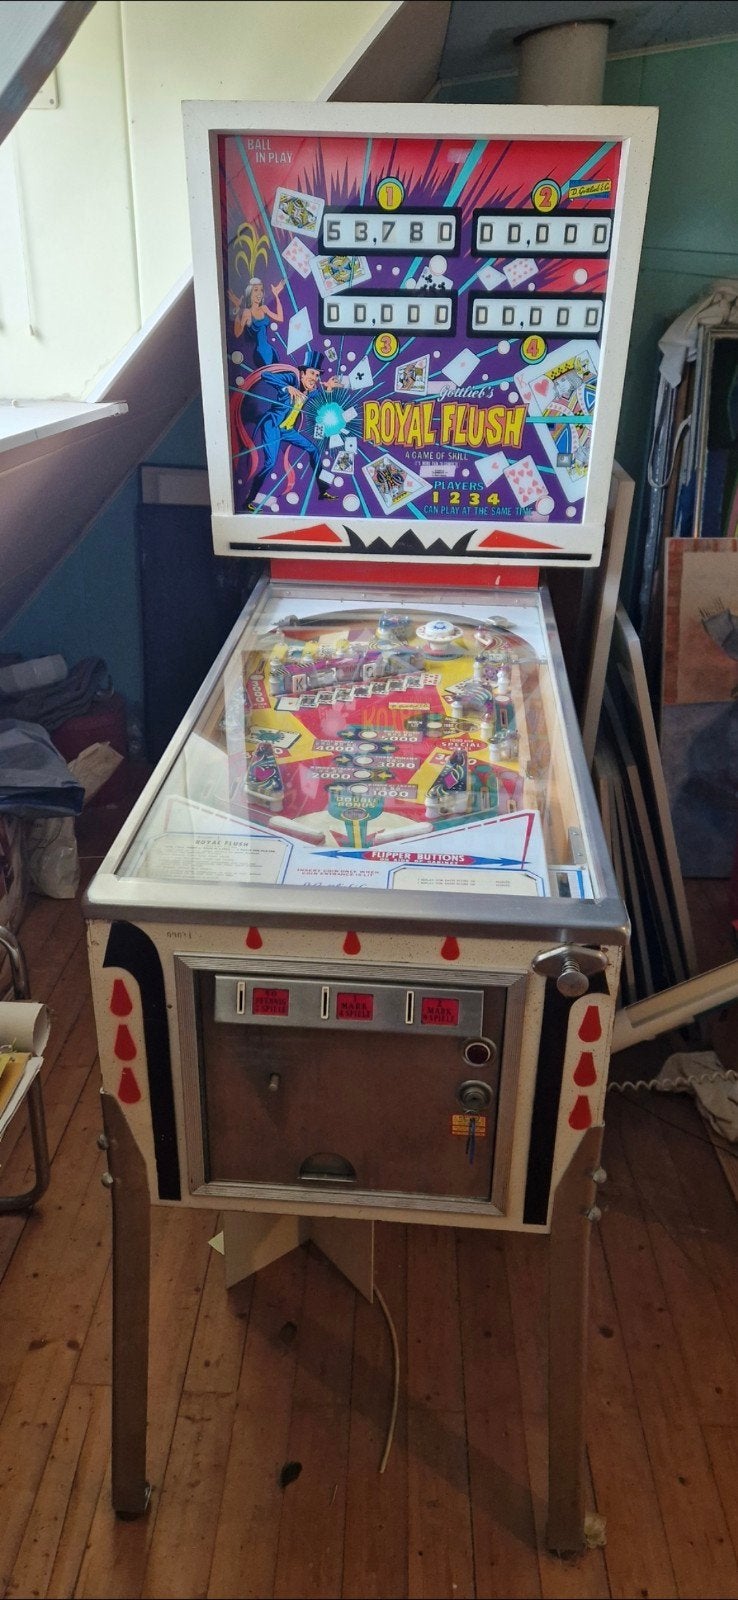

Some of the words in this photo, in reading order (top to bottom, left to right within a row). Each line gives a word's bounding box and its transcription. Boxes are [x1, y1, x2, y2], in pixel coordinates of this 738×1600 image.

[248, 139, 271, 150] BALL
[256, 152, 266, 163] IN
[268, 153, 293, 164] PLAY
[386, 186, 394, 206] 1
[539, 186, 552, 208] 2
[380, 335, 392, 354] 3
[527, 338, 539, 357] 4
[363, 399, 436, 449] ROYAL
[441, 402, 529, 449] FLUSH
[412, 452, 434, 460] GAME
[436, 452, 445, 460] OF
[448, 452, 469, 461] SKILL
[434, 481, 484, 491] PLAYERS
[432, 491, 439, 503] 1
[449, 492, 461, 505] 2
[468, 493, 480, 506] 3
[487, 493, 500, 505] 4
[424, 505, 438, 514] CAN
[440, 506, 459, 515] PLAY
[461, 506, 470, 515] AT
[474, 507, 488, 516] THE
[491, 507, 512, 516] SAME
[516, 507, 533, 516] TIME
[312, 772, 351, 780] 2000
[371, 852, 411, 860] FLIPPER
[417, 853, 465, 862] BUTTONS
